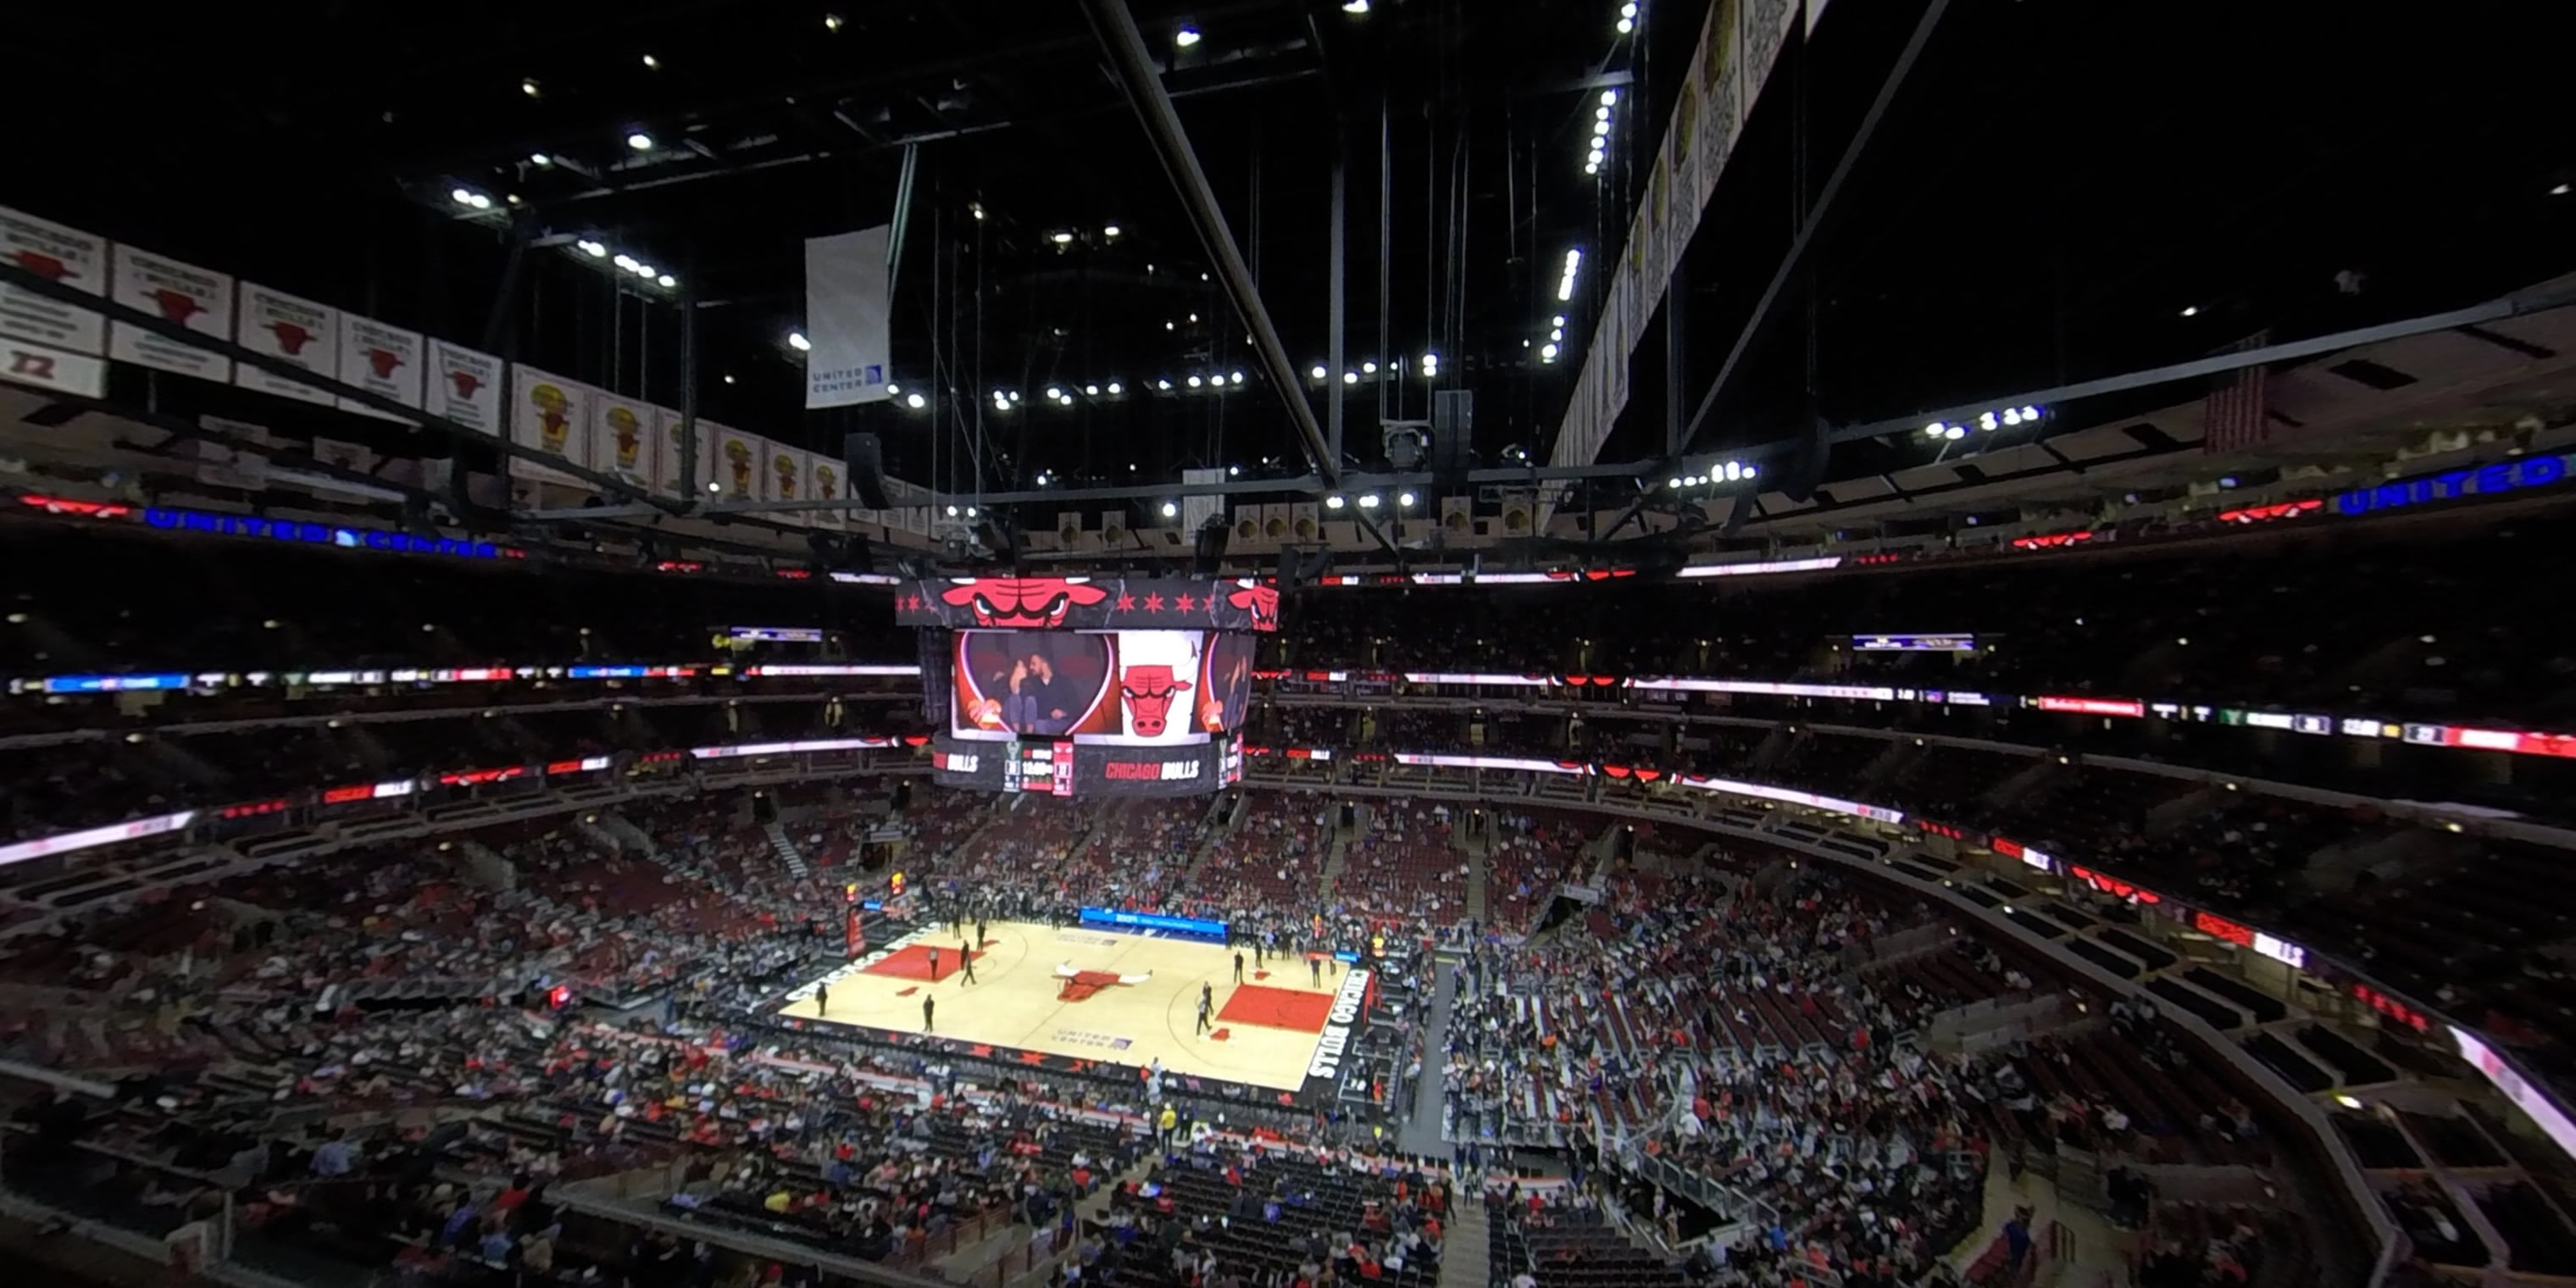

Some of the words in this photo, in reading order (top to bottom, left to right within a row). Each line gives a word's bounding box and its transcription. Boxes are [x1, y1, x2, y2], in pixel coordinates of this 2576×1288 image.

[813, 368, 863, 382] UNITED
[813, 380, 863, 394] CENTER
[2339, 455, 2565, 515] UNITED
[145, 506, 328, 541] UNITED
[365, 530, 497, 558] CENTER
[1105, 760, 1161, 780] CHICAGO
[1161, 759, 1200, 780] BULLS
[1330, 969, 1370, 1024] CHICAGO
[1307, 1025, 1351, 1079] BULLS
